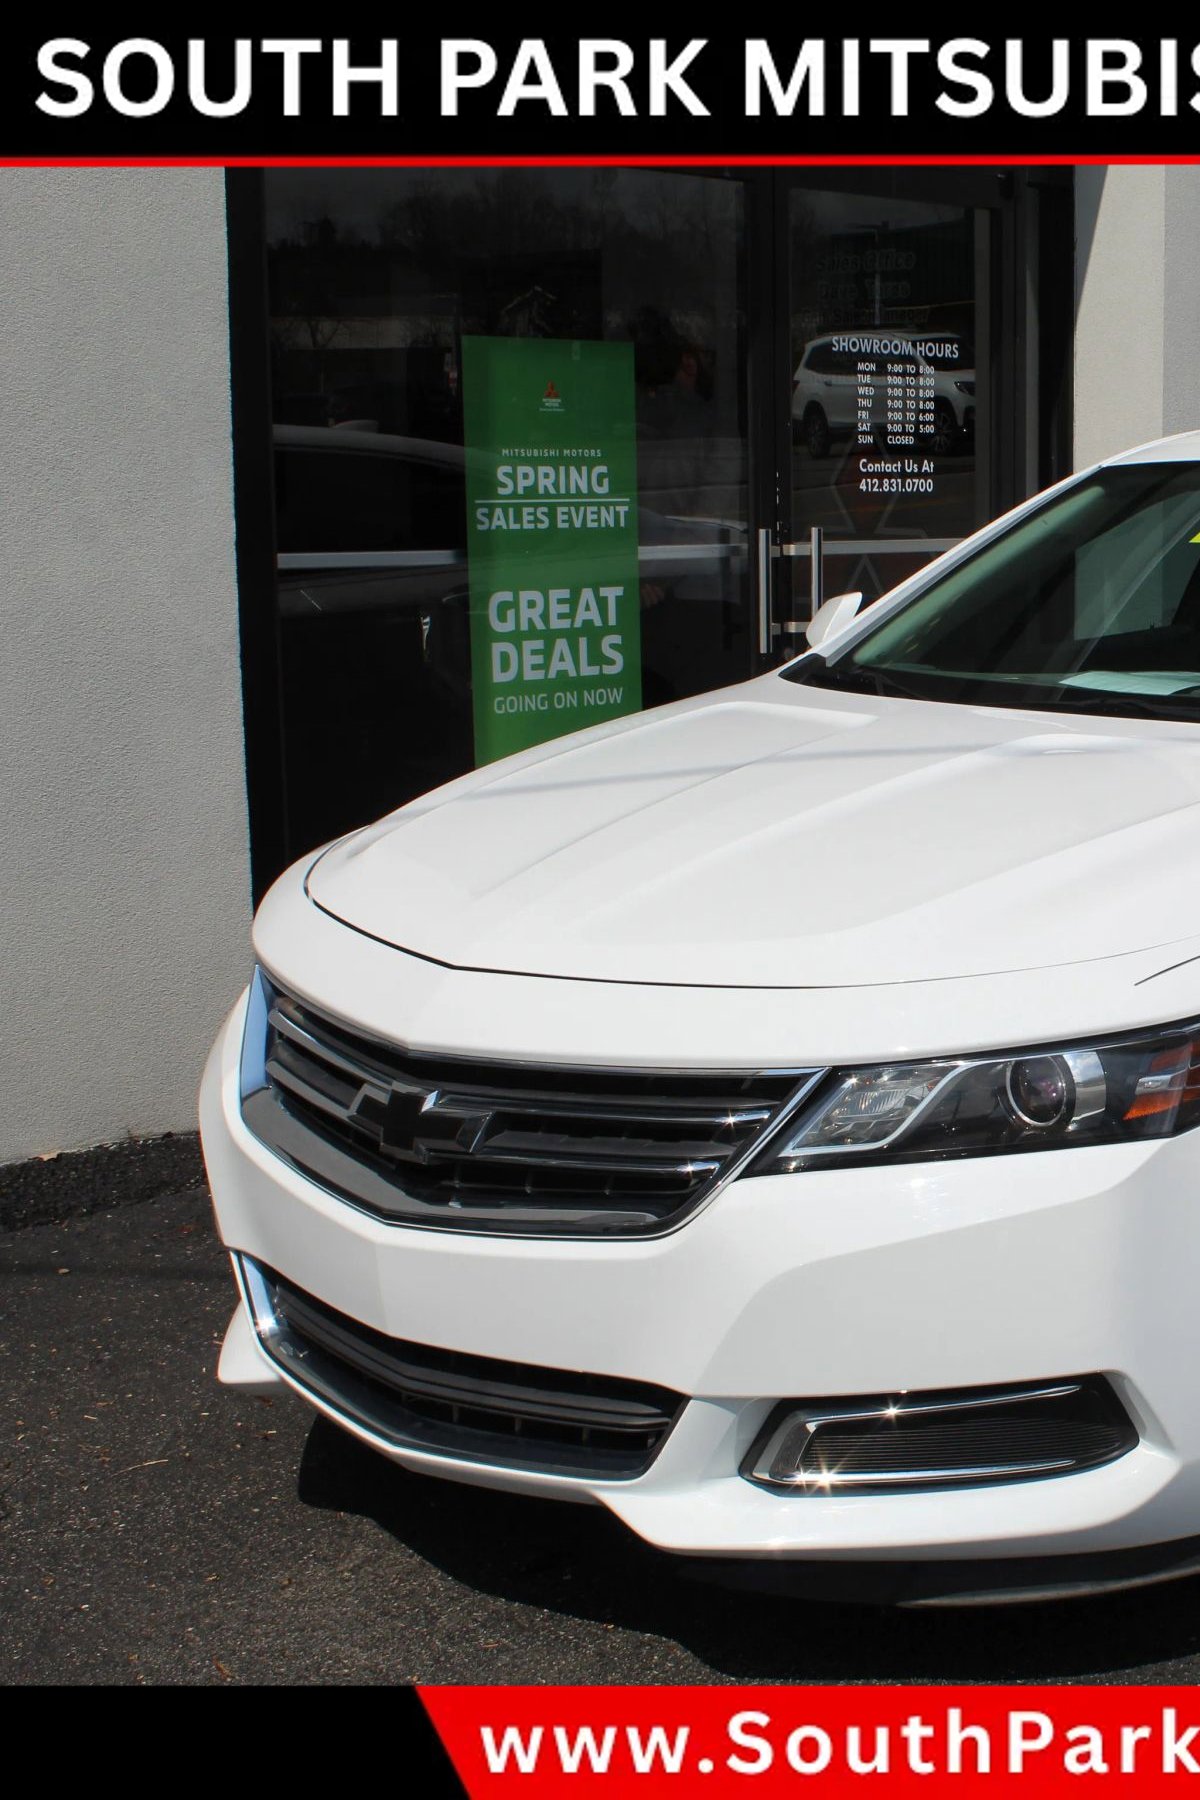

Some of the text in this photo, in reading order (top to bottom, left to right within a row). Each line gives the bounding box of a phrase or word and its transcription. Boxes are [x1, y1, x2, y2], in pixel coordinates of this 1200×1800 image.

[832, 336, 959, 358] SHOWROOM HOURS
[857, 362, 935, 375] MON 9:00 TO 8:00
[857, 374, 935, 386] TUE 9:00 TO 8:00
[857, 387, 935, 398] WED 9:00 TO 8:00
[857, 399, 935, 410] THU 9:00 TO 8:00
[857, 411, 935, 422] FRI 9:00 TO 6:00
[857, 423, 935, 434] SAT 9:00 TO 5:00
[857, 435, 915, 445] SUN CLOSED
[501, 448, 602, 457] MITSUBISHI MOTORS
[859, 458, 935, 473] Contact Us At
[496, 465, 610, 496] SPRING
[859, 478, 934, 492] 412.831.0700
[475, 505, 630, 530] SALES EVENT
[488, 586, 625, 633] GREAT
[491, 634, 625, 684] DEALS
[494, 687, 624, 715] GOING ON NOW
